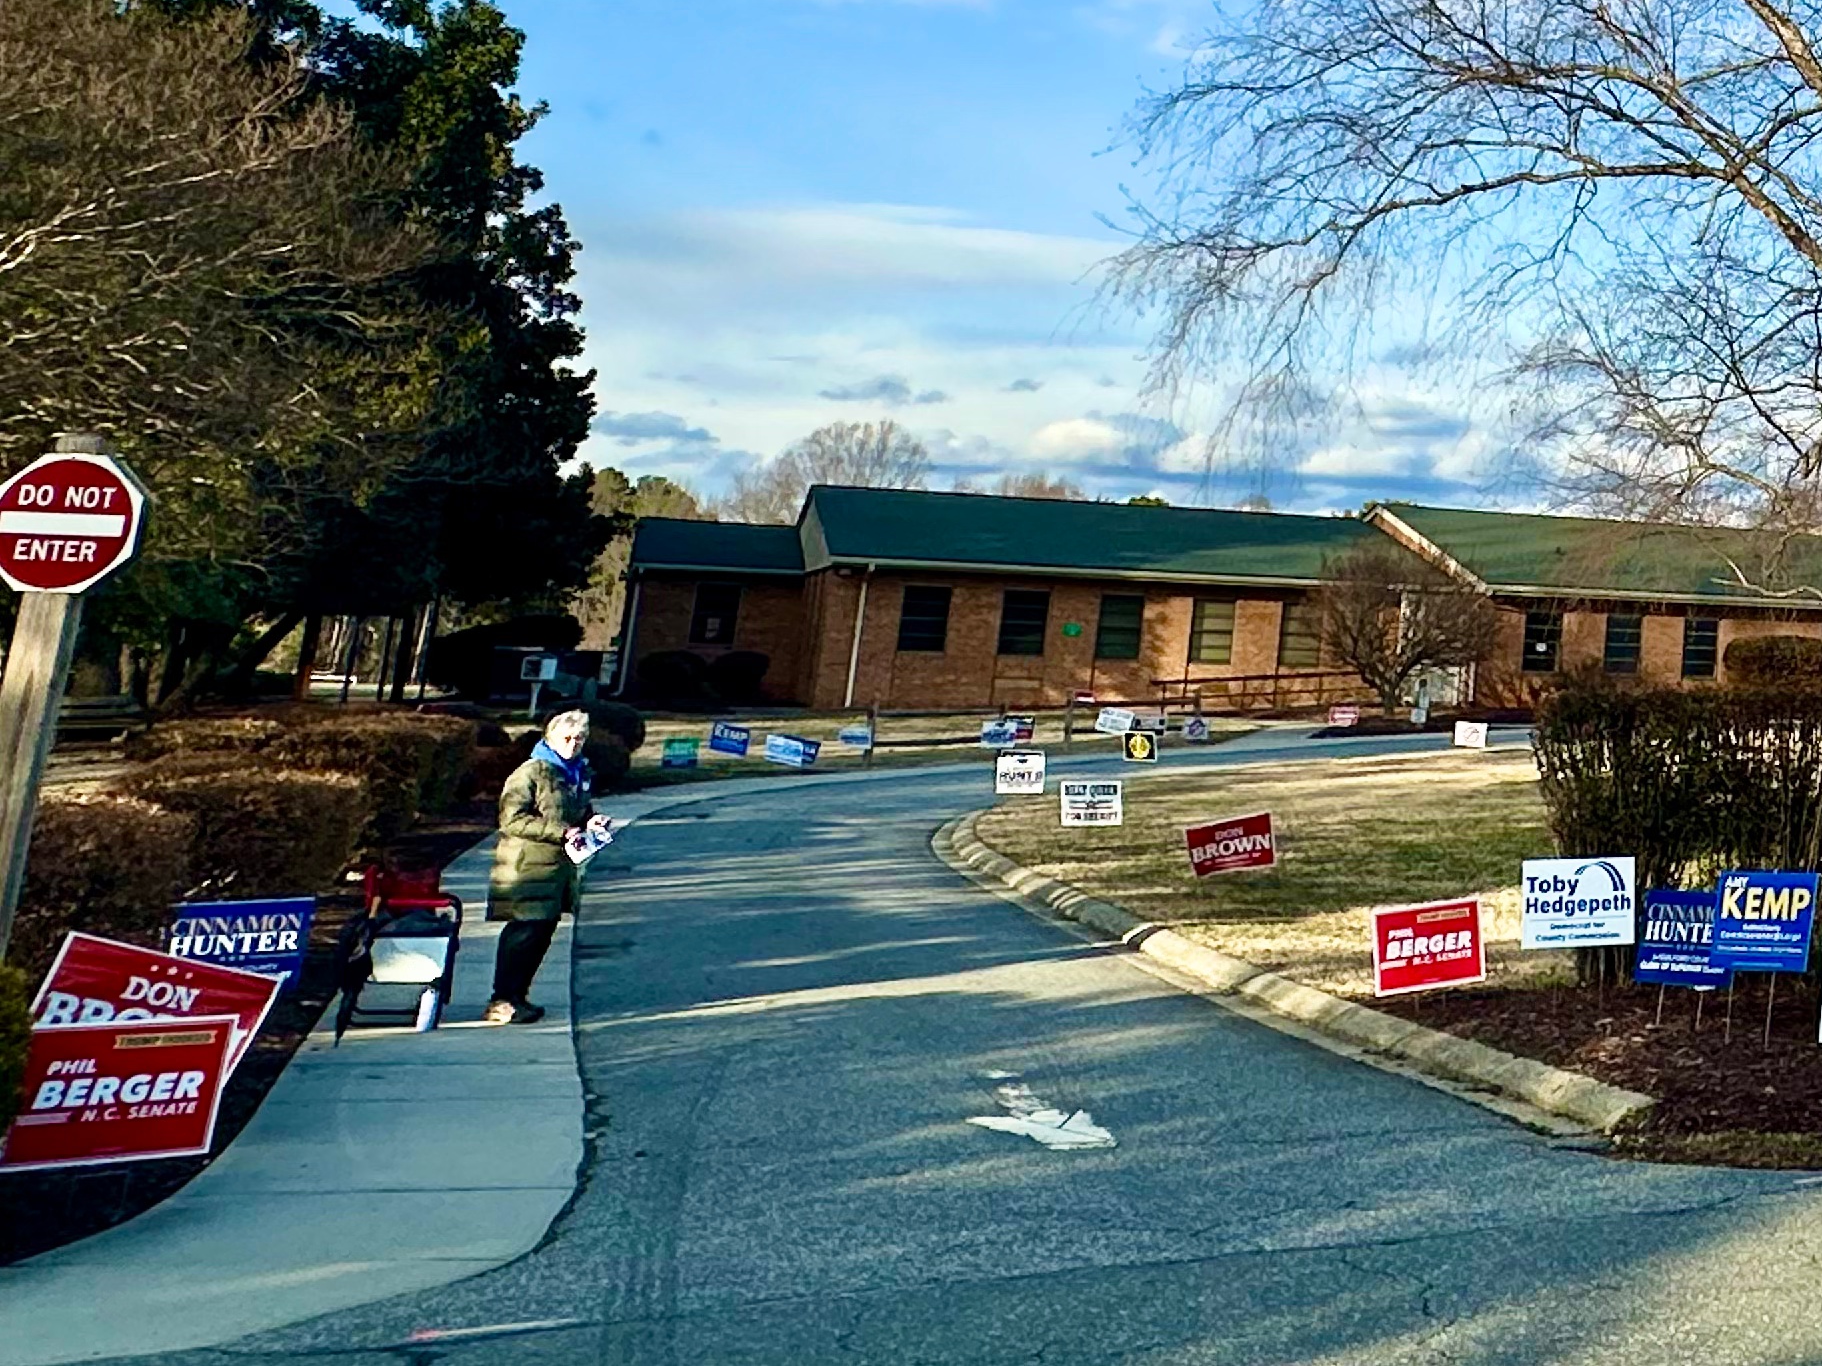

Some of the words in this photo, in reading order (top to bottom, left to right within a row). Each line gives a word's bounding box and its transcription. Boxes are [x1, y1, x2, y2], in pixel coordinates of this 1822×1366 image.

[18, 484, 54, 506] DO
[64, 486, 117, 509] NOT
[12, 538, 98, 563] ENTER
[1192, 833, 1270, 864] BROWN
[1526, 875, 1579, 896] Toby
[1648, 902, 1715, 923] CINNAM
[1721, 886, 1811, 921] KEMP
[170, 912, 304, 937] CINNAMON
[1645, 920, 1713, 944] HUNTE
[168, 930, 298, 957] HUNTER
[1386, 930, 1472, 960] BERGER
[119, 975, 202, 1012] DON
[47, 1058, 97, 1075] PHIL
[31, 1070, 206, 1110] BERGER
[80, 1108, 121, 1122] N.C.
[127, 1101, 198, 1119] SENATE
